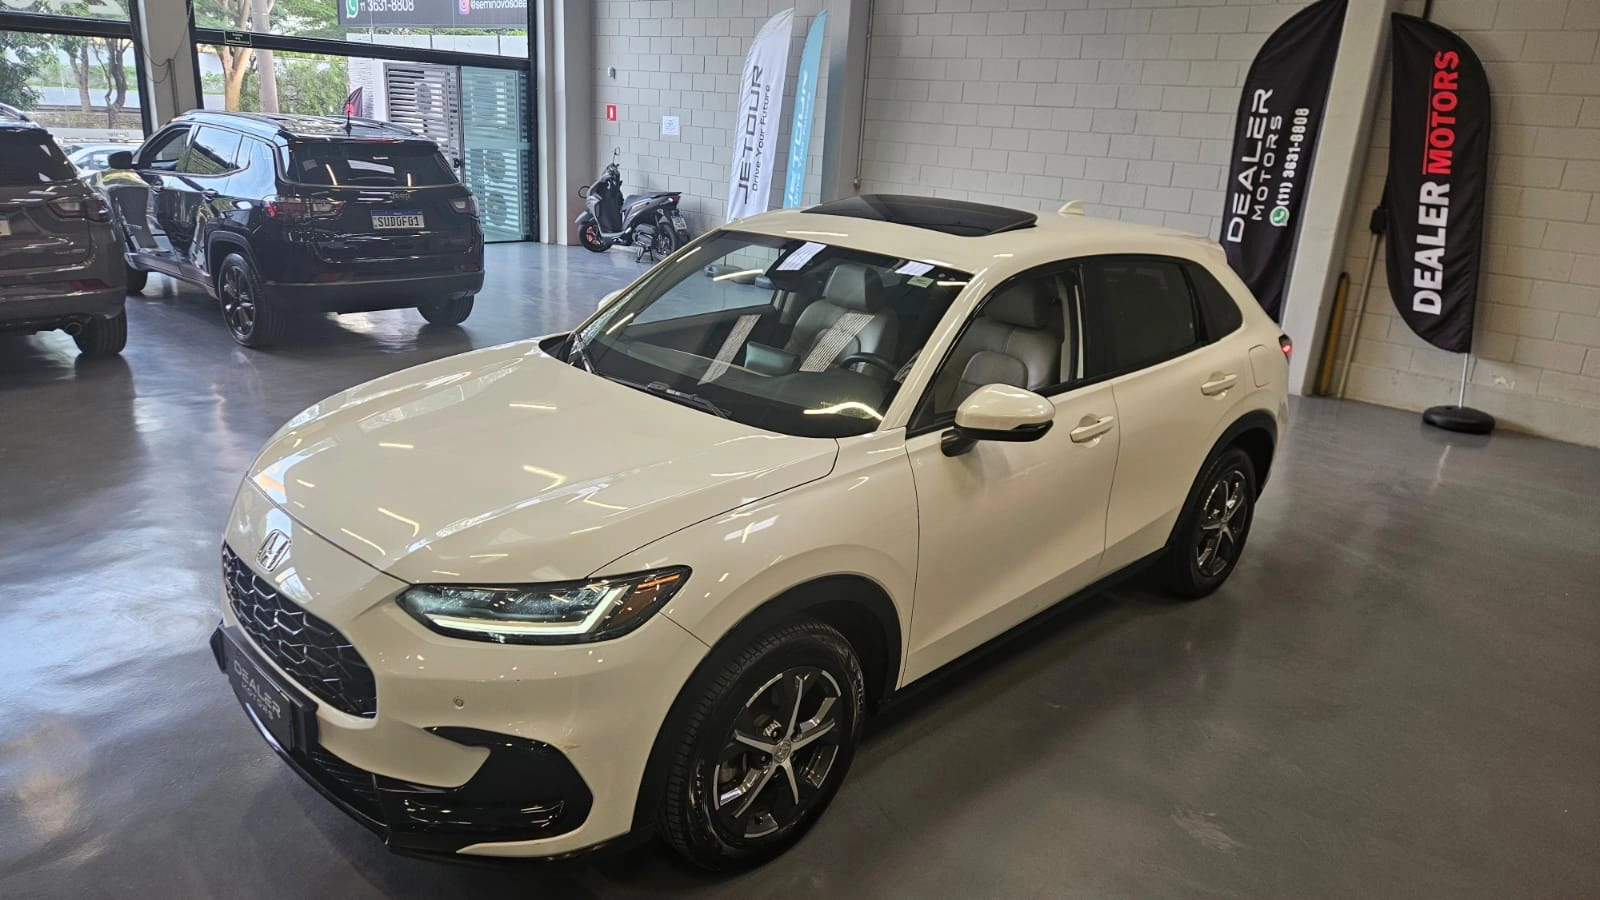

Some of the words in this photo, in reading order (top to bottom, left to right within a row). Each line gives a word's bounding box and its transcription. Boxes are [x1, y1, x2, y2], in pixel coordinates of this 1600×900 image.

[738, 65, 763, 204] JETOUR
[760, 85, 770, 125] Future
[1427, 51, 1459, 175] MOTORS
[752, 159, 761, 191] Drive
[755, 127, 765, 157] Your
[1227, 88, 1273, 243] DEALER
[1251, 115, 1282, 221] MOTORS
[1282, 108, 1310, 178] 3631-8808
[1276, 182, 1293, 205] (11)
[1412, 181, 1450, 315] DEALER
[233, 660, 280, 718] DEALER
